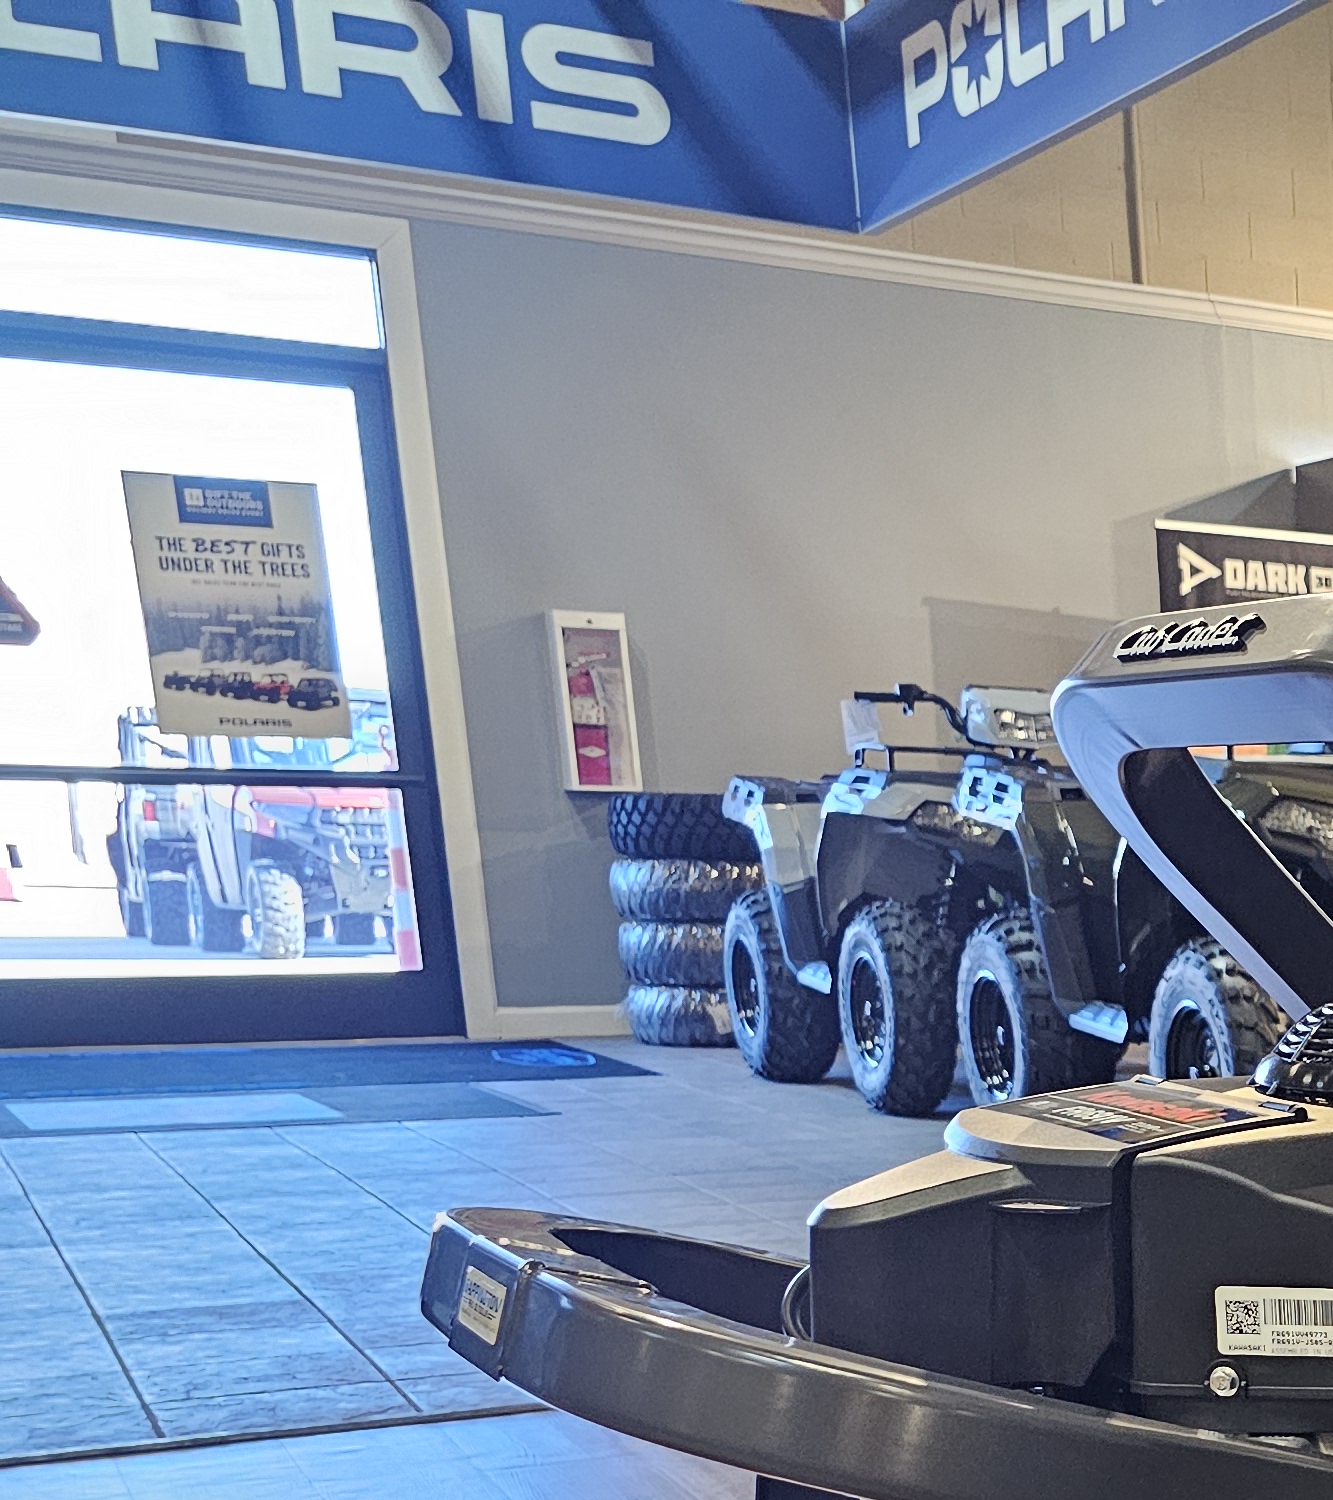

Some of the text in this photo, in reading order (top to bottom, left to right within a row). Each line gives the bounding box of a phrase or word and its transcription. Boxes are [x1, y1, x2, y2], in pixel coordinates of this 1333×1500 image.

[155, 535, 306, 560] THE BEST GIFTS
[158, 555, 311, 579] UNDER THE TREES
[1223, 557, 1308, 594] DARK
[218, 716, 293, 728] POLARIS
